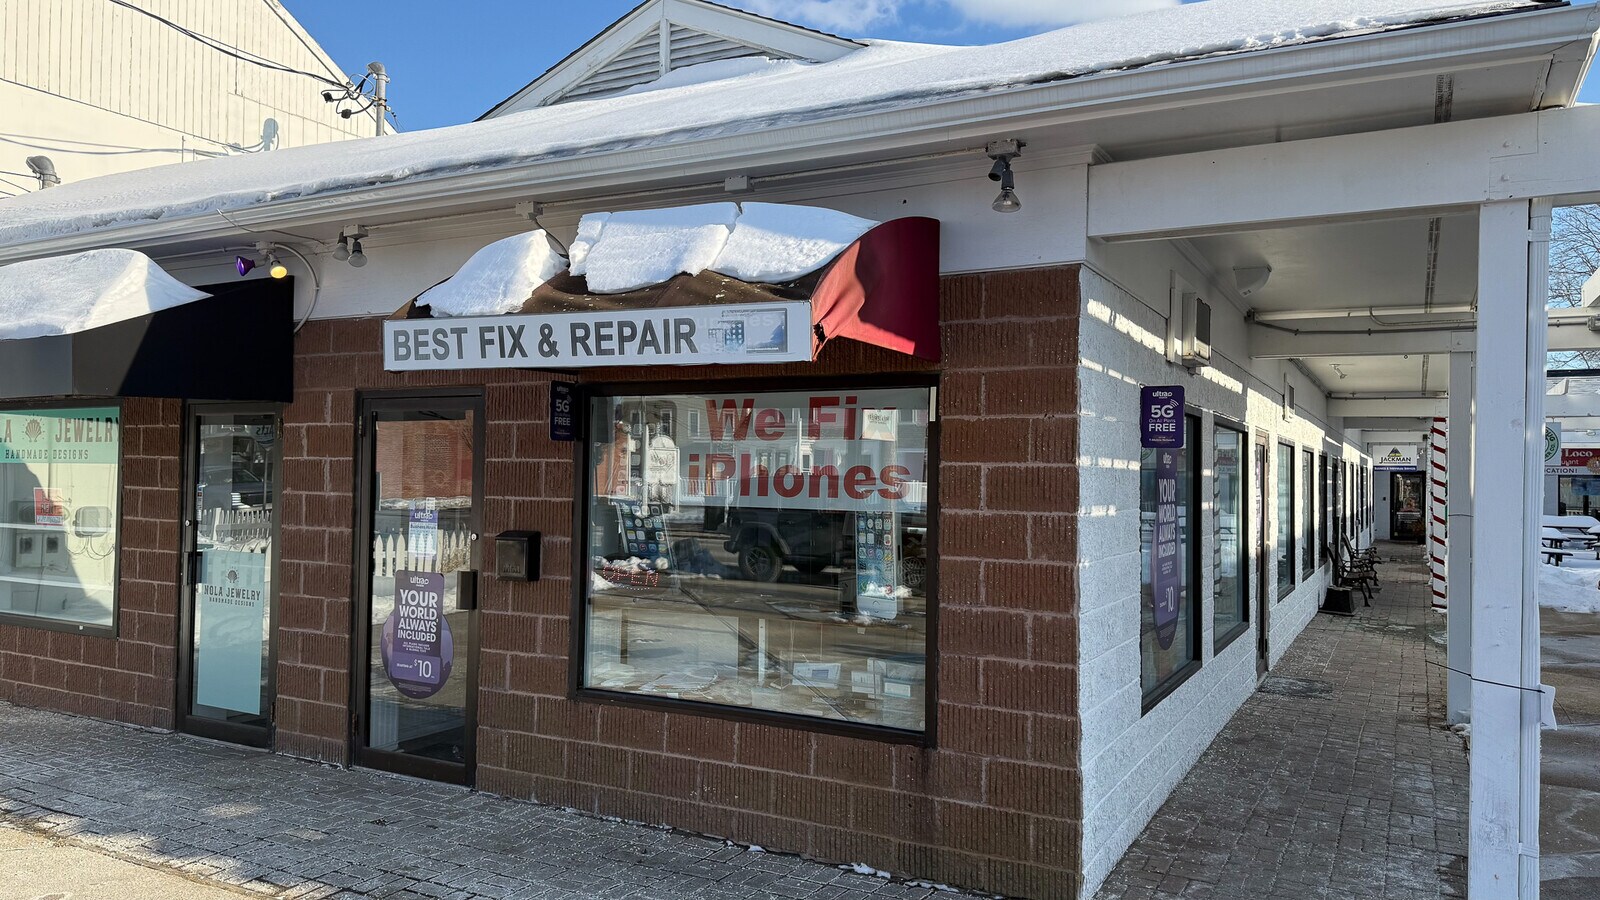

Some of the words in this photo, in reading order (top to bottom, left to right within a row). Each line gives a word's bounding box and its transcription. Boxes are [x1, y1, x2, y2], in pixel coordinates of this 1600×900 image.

[392, 326, 468, 362] BEST
[478, 324, 529, 359] FIX
[537, 322, 560, 358] &
[569, 317, 699, 357] REPAIR
[1152, 390, 1173, 398] ultra
[555, 399, 570, 413] 5G
[1151, 404, 1174, 418] 5G
[554, 416, 571, 426] FREE
[704, 398, 786, 441] We
[808, 396, 897, 441] Fi
[1148, 423, 1176, 432] FREE
[5, 449, 48, 459] HANDMADE
[52, 449, 89, 459] DESIGNS
[1379, 456, 1412, 464] JACKMAN
[1565, 449, 1593, 457] Loco
[687, 453, 911, 500] iPhones
[1159, 478, 1176, 502] YOUR
[1158, 522, 1176, 543] ALWAYS
[410, 576, 429, 585] ultra
[603, 564, 659, 587] OPEN
[204, 585, 223, 597] NOLA
[226, 587, 261, 601] JEWELRY
[400, 589, 438, 608] YOUR
[399, 604, 438, 623] WORLD,
[398, 617, 437, 633] ALWAYS
[397, 629, 436, 643] INCLUDED
[414, 659, 432, 678] $10
